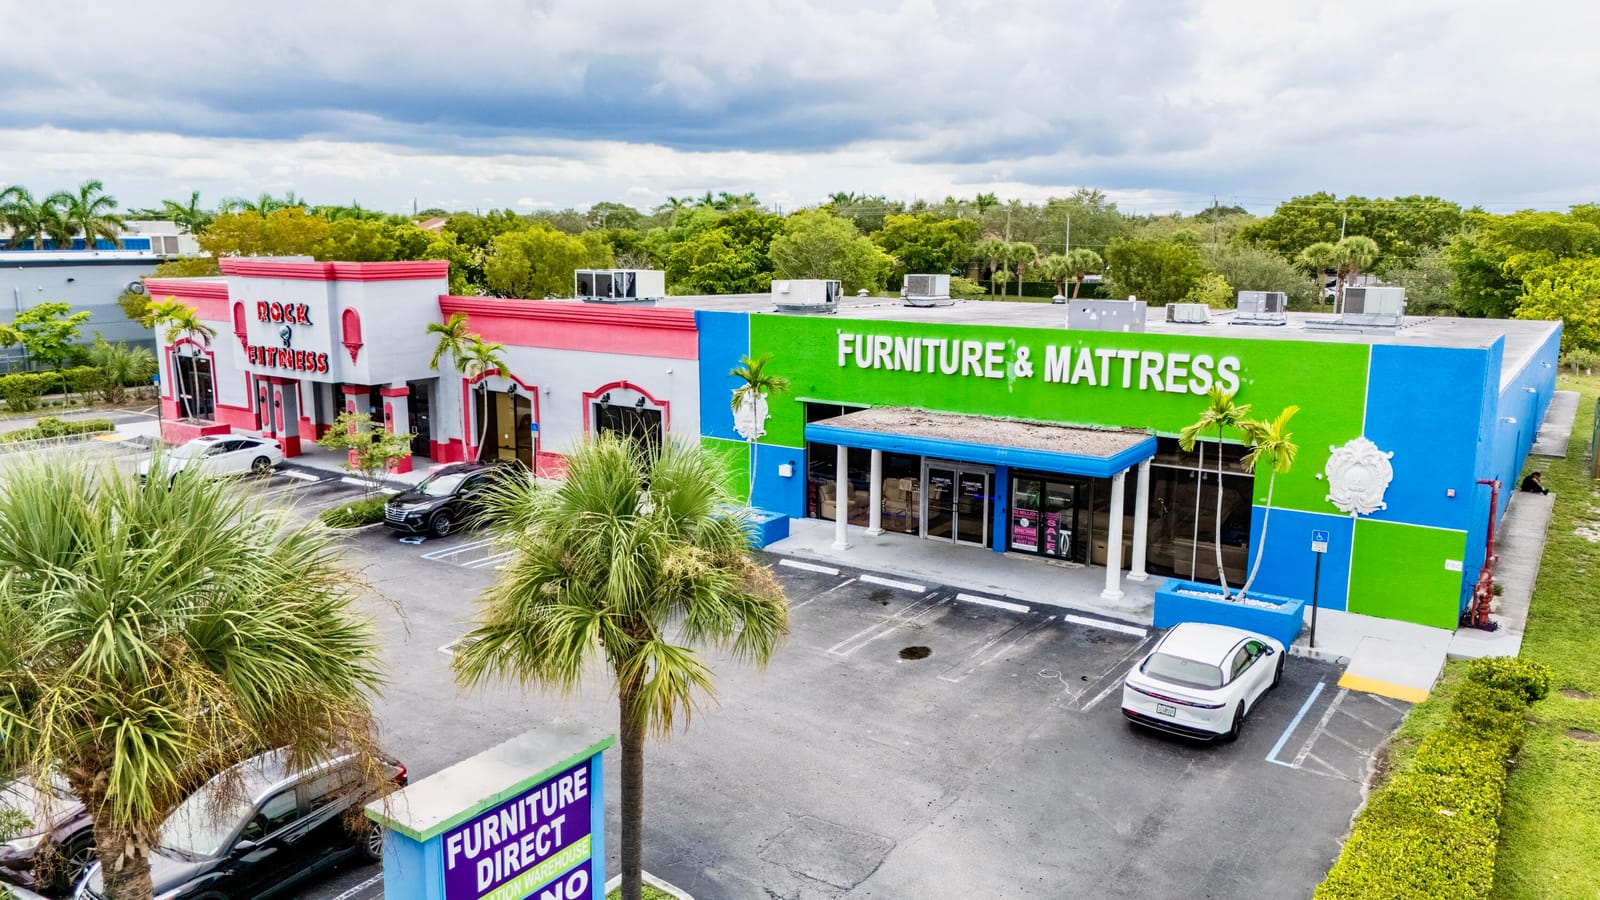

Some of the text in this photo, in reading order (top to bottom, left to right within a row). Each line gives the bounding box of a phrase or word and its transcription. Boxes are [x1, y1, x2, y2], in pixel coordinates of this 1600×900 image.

[256, 301, 312, 325] ROCK
[247, 345, 329, 374] FITNESS
[837, 333, 1241, 396] FURNITURE & MATTRESS
[1046, 519, 1056, 550] SALE
[447, 767, 588, 870] FURNITURE
[477, 814, 566, 893] DIRECT
[523, 841, 589, 891] WAREHOUSE
